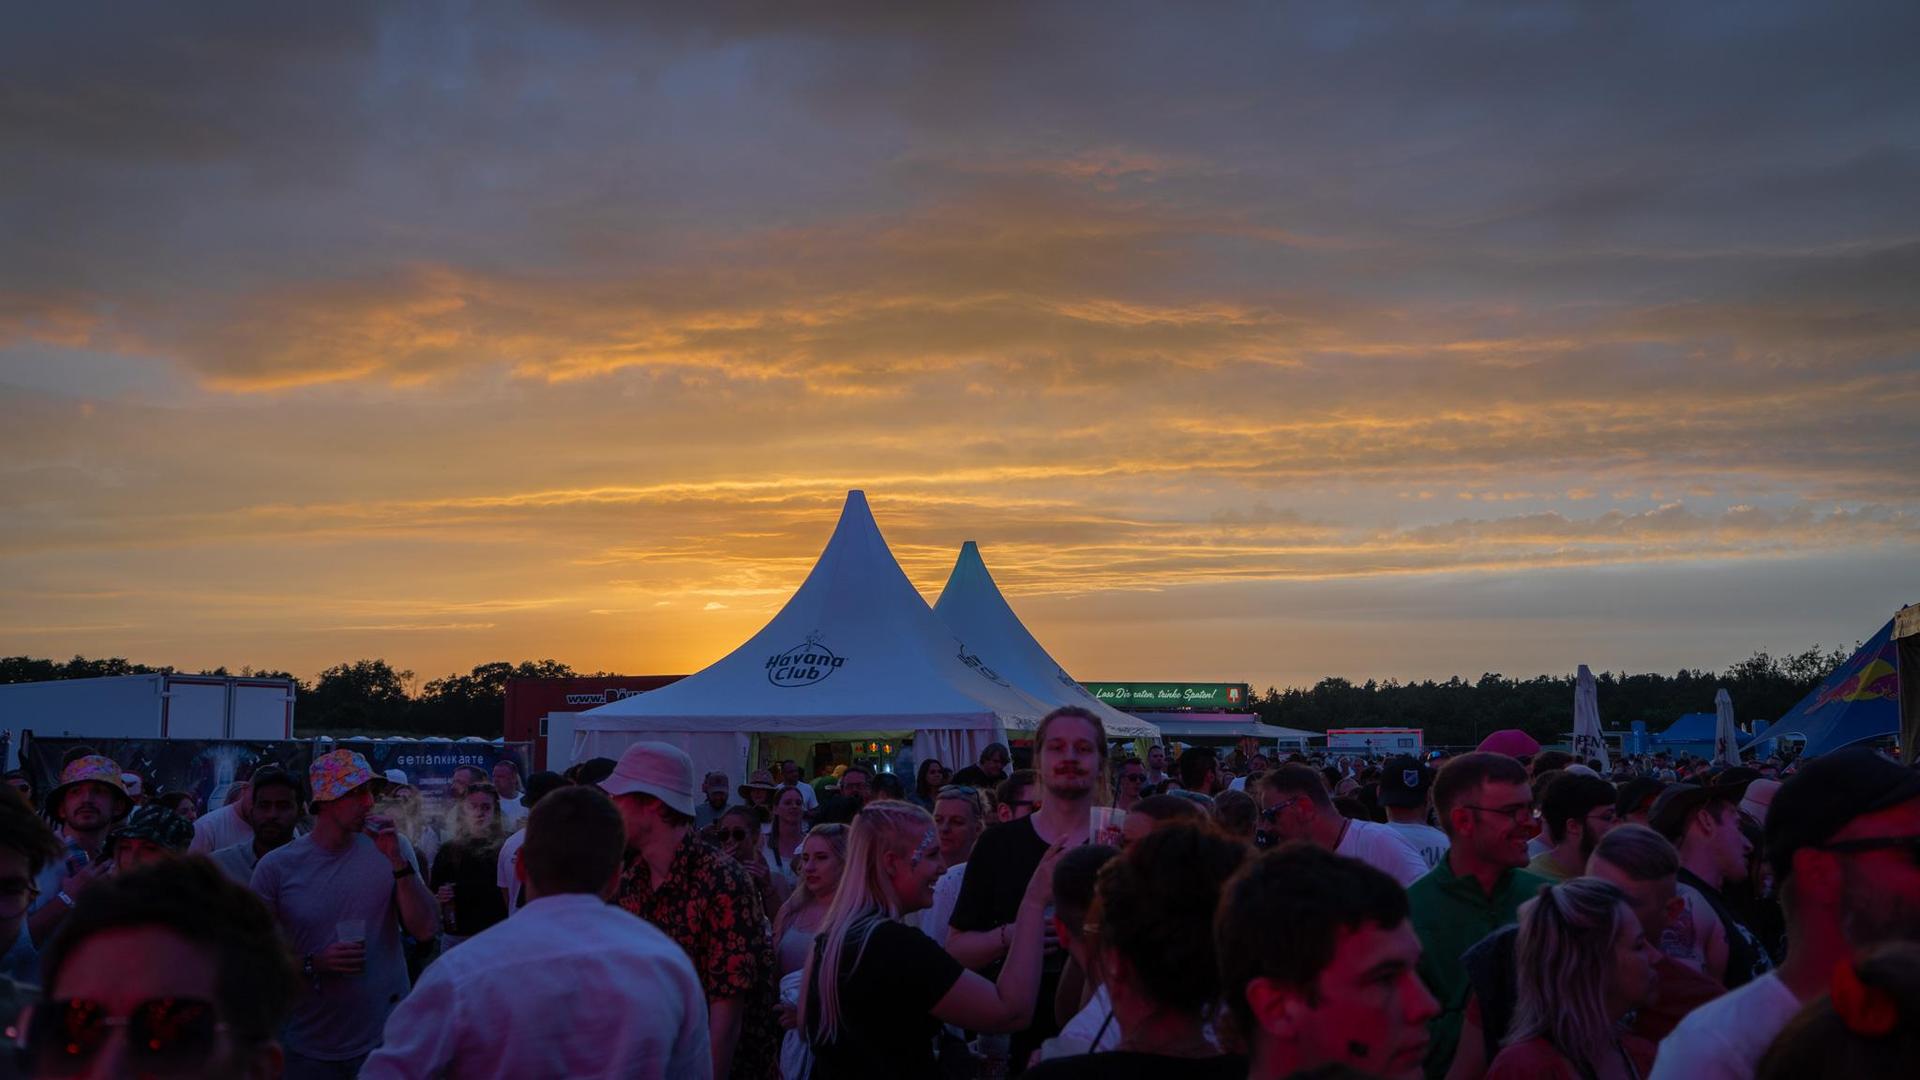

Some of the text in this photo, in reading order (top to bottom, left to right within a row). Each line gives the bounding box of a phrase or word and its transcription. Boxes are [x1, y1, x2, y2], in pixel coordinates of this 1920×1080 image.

[764, 653, 845, 669] Havana
[775, 666, 820, 680] Club
[1183, 688, 1217, 702] Spaten!
